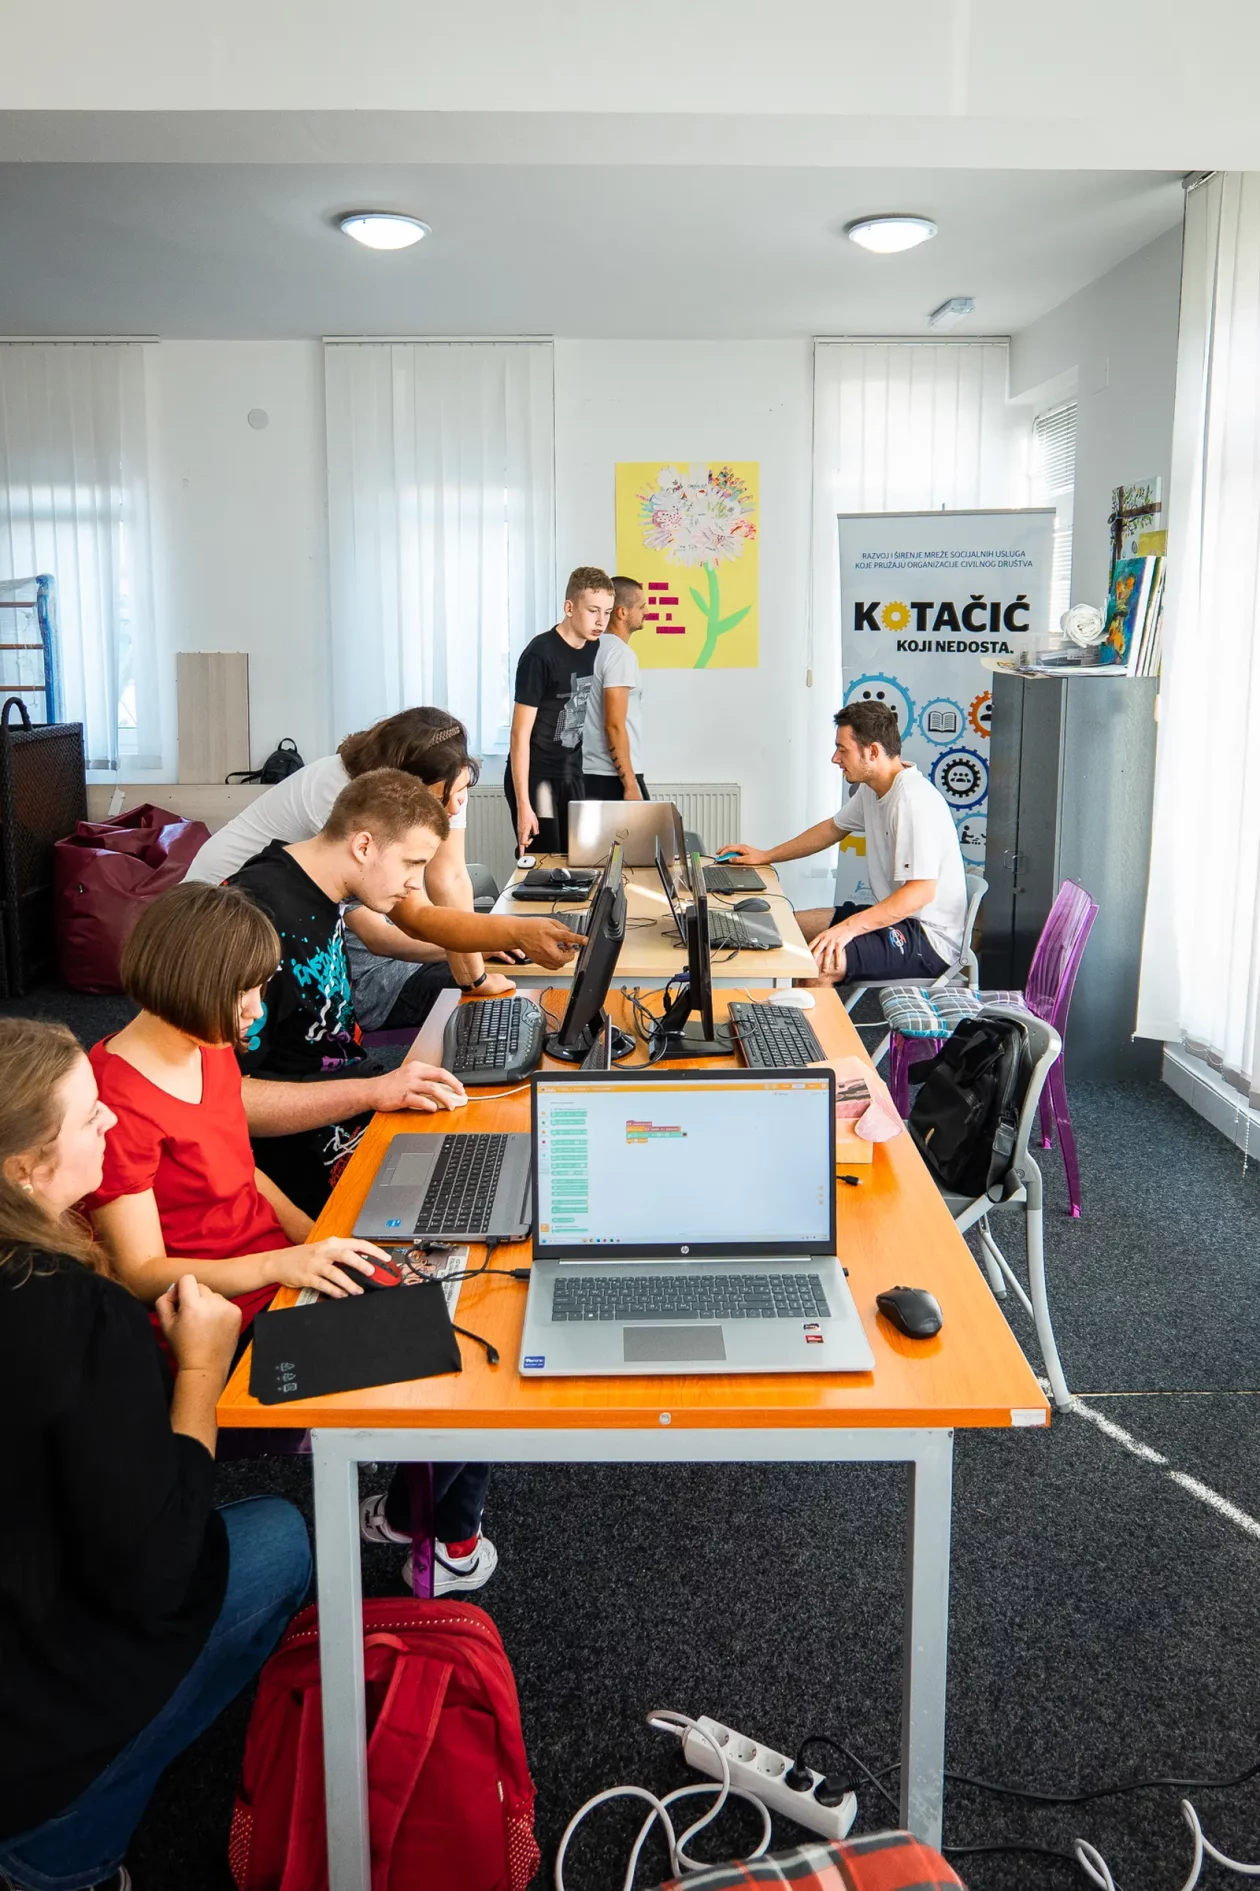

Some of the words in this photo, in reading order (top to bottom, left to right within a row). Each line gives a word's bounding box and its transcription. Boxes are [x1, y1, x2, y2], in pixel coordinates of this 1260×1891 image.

[862, 552, 890, 560] RAZVOJ
[894, 551, 923, 559] ŠIRENJE
[924, 551, 949, 559] MREŽE
[995, 550, 1026, 558] USLUGA
[874, 561, 906, 569] PRUŽAJU
[960, 560, 996, 568] CIVILNOG
[998, 559, 1033, 567] DRUŠTVA
[854, 595, 1030, 632] KOTAČIĆ
[897, 640, 932, 652] KOJI
[936, 641, 1014, 654] NEDOSTA.
